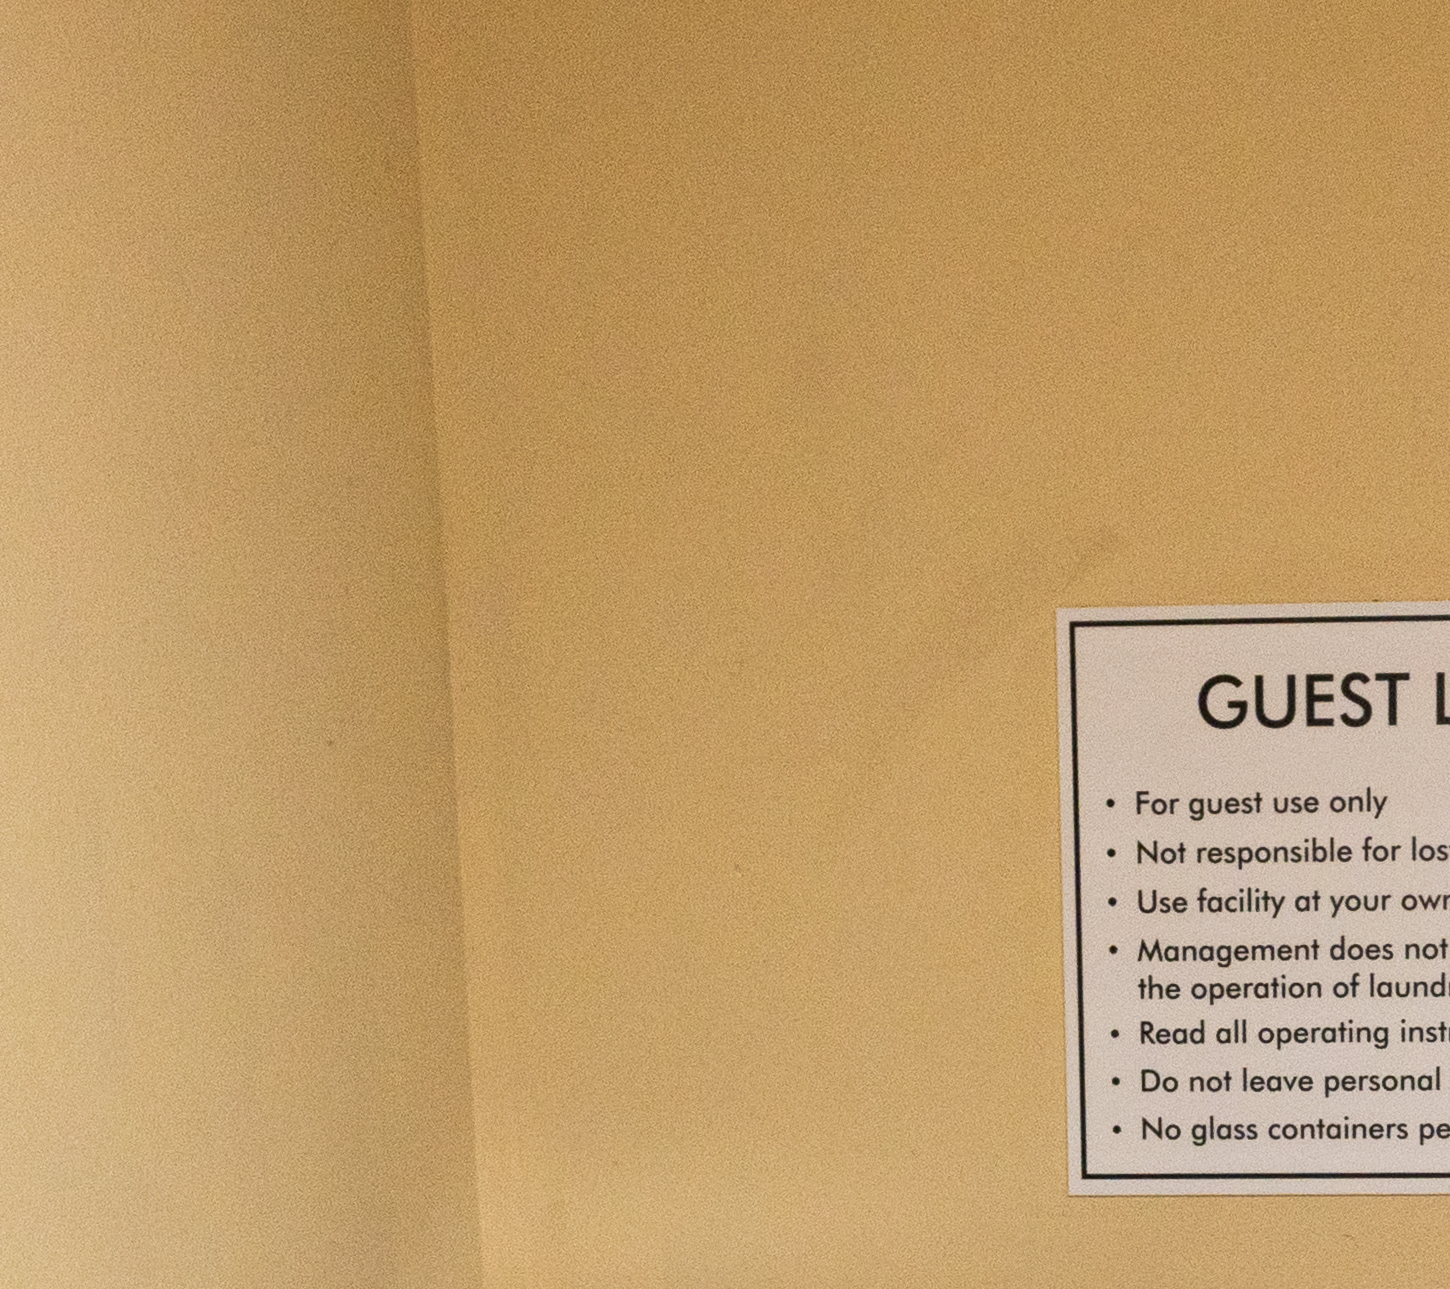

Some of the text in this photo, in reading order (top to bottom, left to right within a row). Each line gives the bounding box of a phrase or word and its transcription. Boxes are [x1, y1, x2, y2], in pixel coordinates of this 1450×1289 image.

[1198, 672, 1410, 729] GUEST
[1137, 787, 1387, 821] For guest use only
[1137, 841, 1186, 864] Not
[1197, 838, 1352, 870] responsible
[1362, 836, 1401, 862] for
[1138, 890, 1187, 913] Use
[1197, 887, 1285, 918] facility
[1295, 891, 1320, 912] at
[1330, 895, 1391, 918] your
[1138, 940, 1319, 967] Management
[1330, 936, 1393, 960] does
[1406, 939, 1448, 960] not
[1138, 975, 1180, 999] the
[1191, 978, 1321, 1005] operation
[1333, 973, 1359, 998] of
[1141, 1020, 1204, 1044] Read
[1216, 1019, 1246, 1044] all
[1258, 1022, 1388, 1050] operating
[1141, 1069, 1178, 1092] Do
[1190, 1071, 1231, 1092] not
[1243, 1068, 1313, 1092] leave
[1325, 1067, 1440, 1097] personal
[1142, 1117, 1181, 1140] No
[1192, 1116, 1257, 1146] glass
[1269, 1119, 1408, 1140] containers
